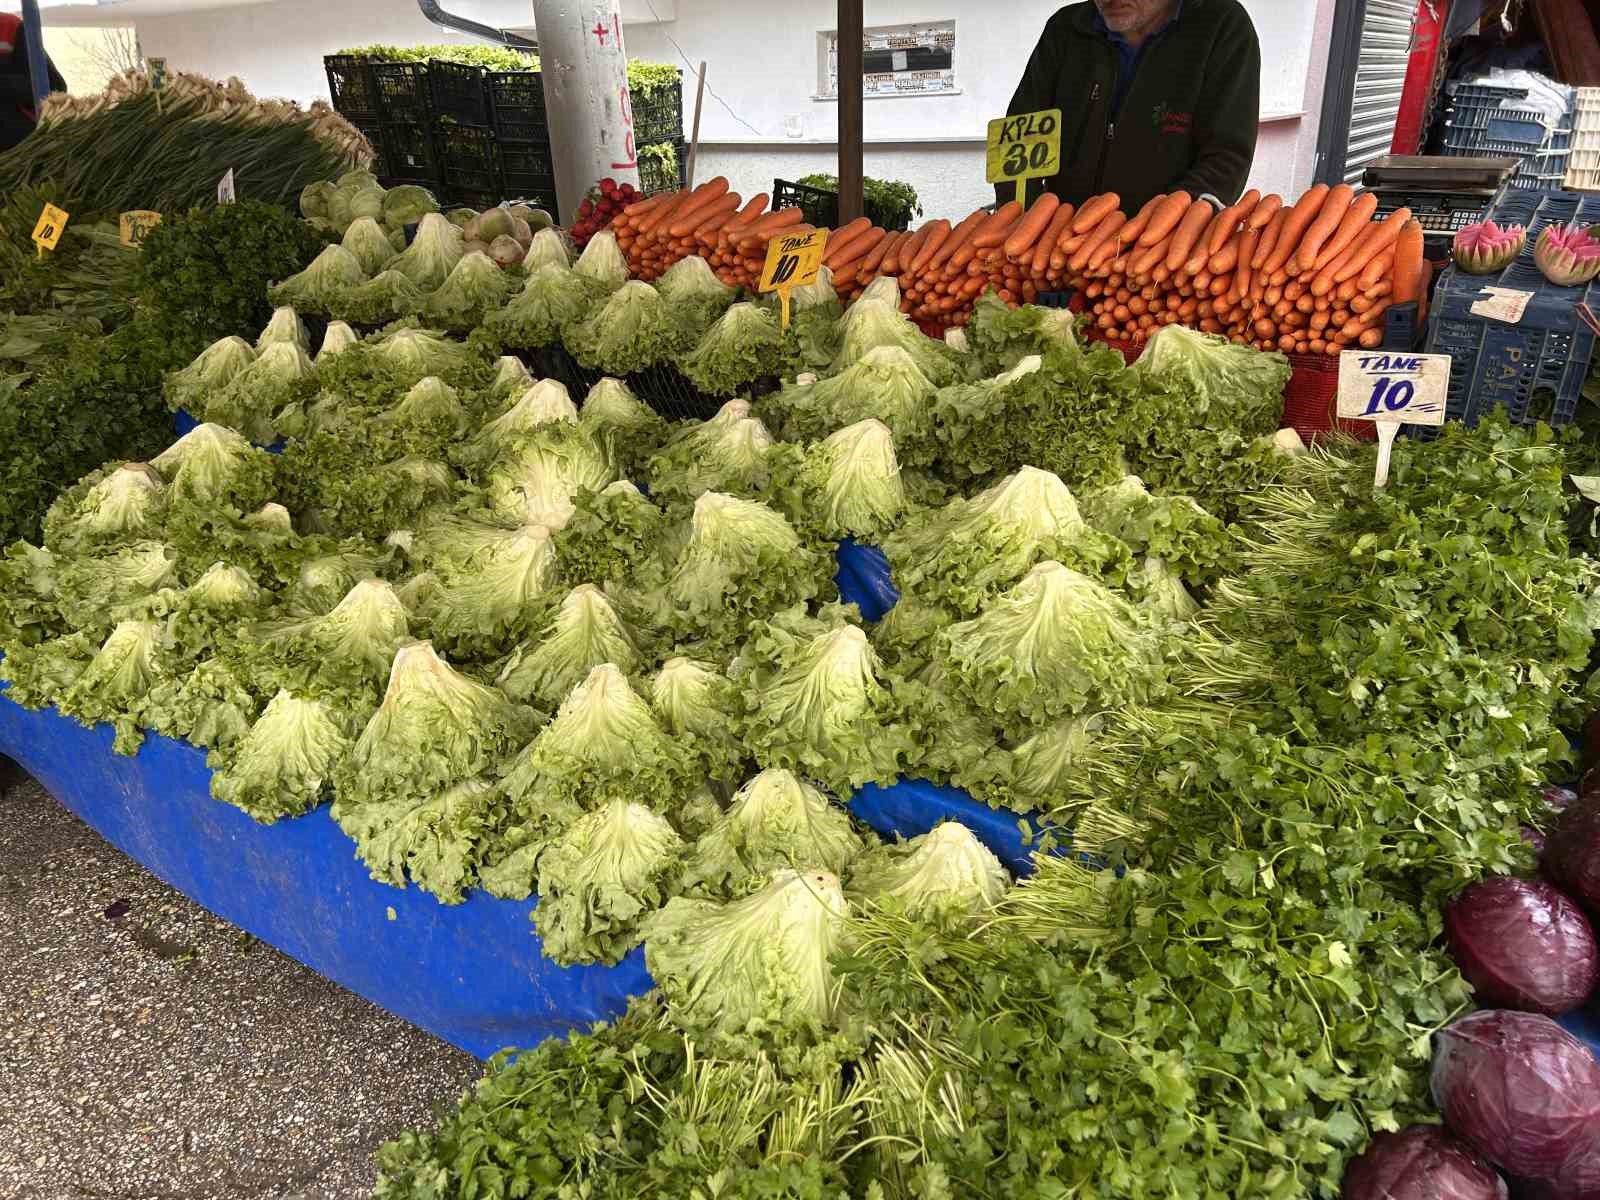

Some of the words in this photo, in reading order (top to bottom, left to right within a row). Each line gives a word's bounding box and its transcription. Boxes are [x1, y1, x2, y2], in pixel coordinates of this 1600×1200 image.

[39, 223, 54, 239] 10
[780, 233, 816, 251] TANE
[769, 255, 799, 285] 10
[1358, 355, 1428, 370] TANE
[1359, 377, 1414, 416] 10
